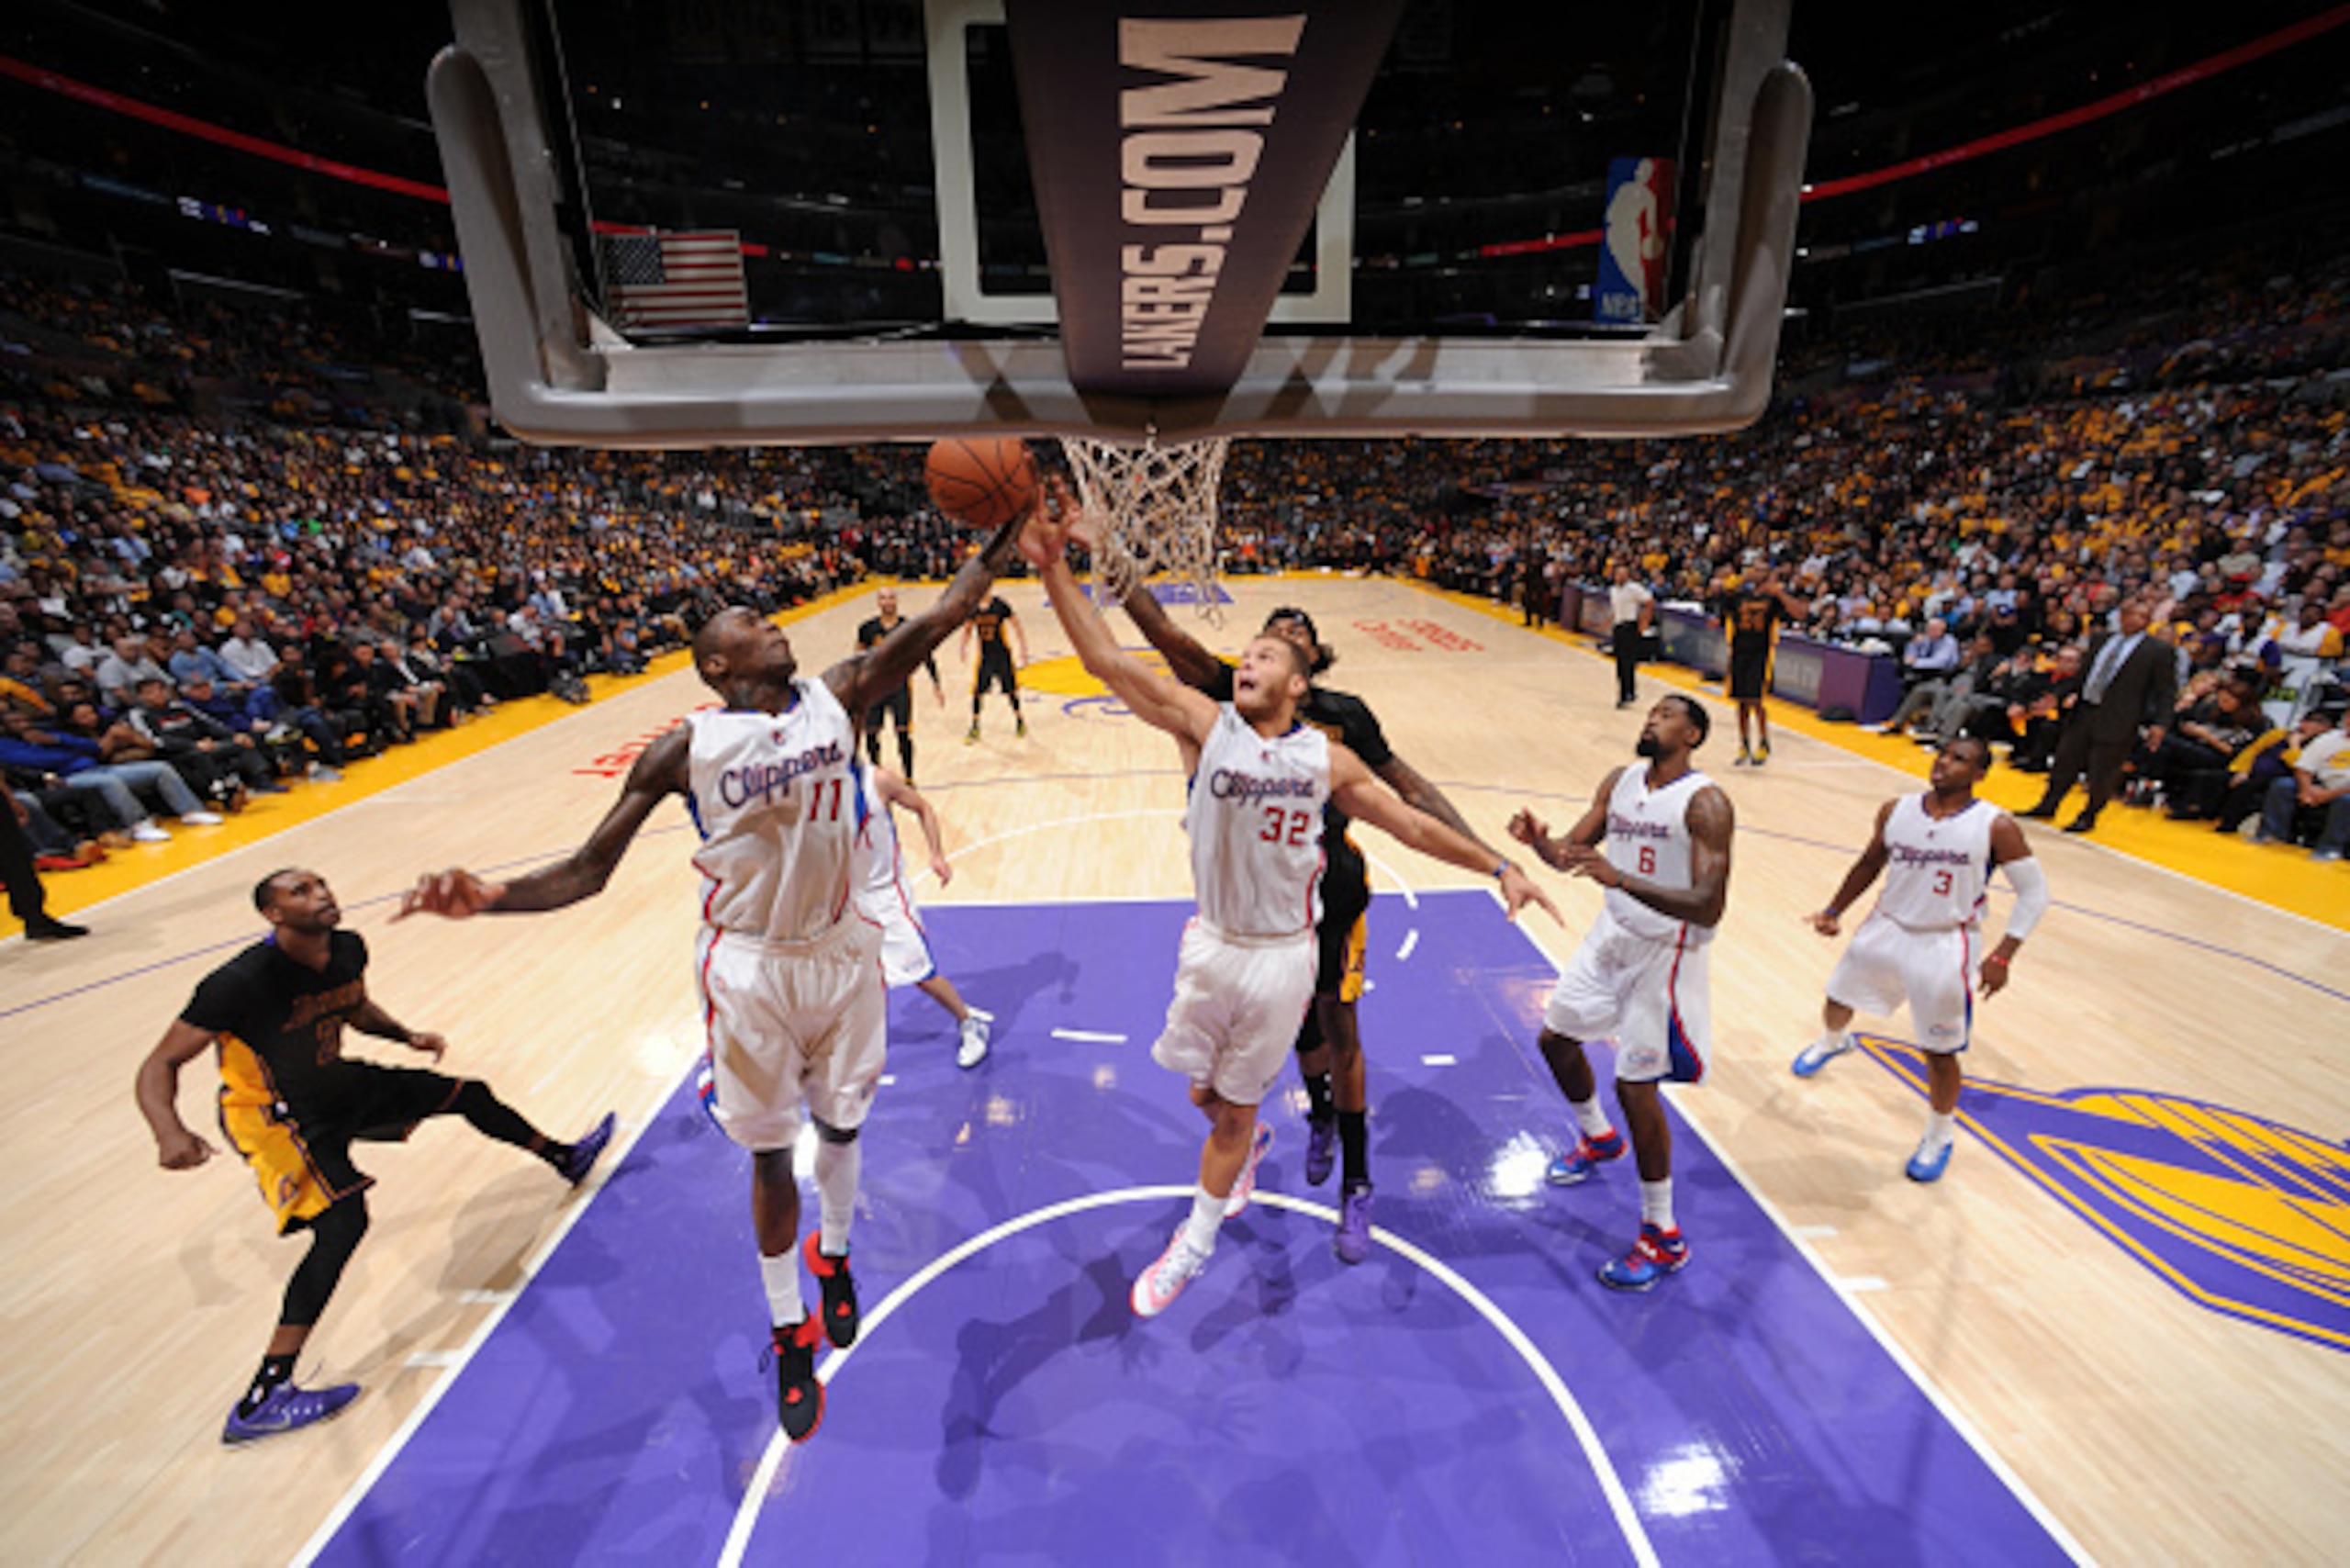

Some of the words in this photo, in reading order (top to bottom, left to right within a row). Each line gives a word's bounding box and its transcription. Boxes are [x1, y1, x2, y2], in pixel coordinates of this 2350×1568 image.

[1117, 13, 1308, 369] LAKERS.COM
[720, 738, 846, 809] Clippers
[1211, 769, 1315, 807] Clippers
[808, 778, 843, 822] 11
[1259, 806, 1310, 846] 32
[1639, 846, 1655, 874] 6
[1932, 869, 1953, 897] 3
